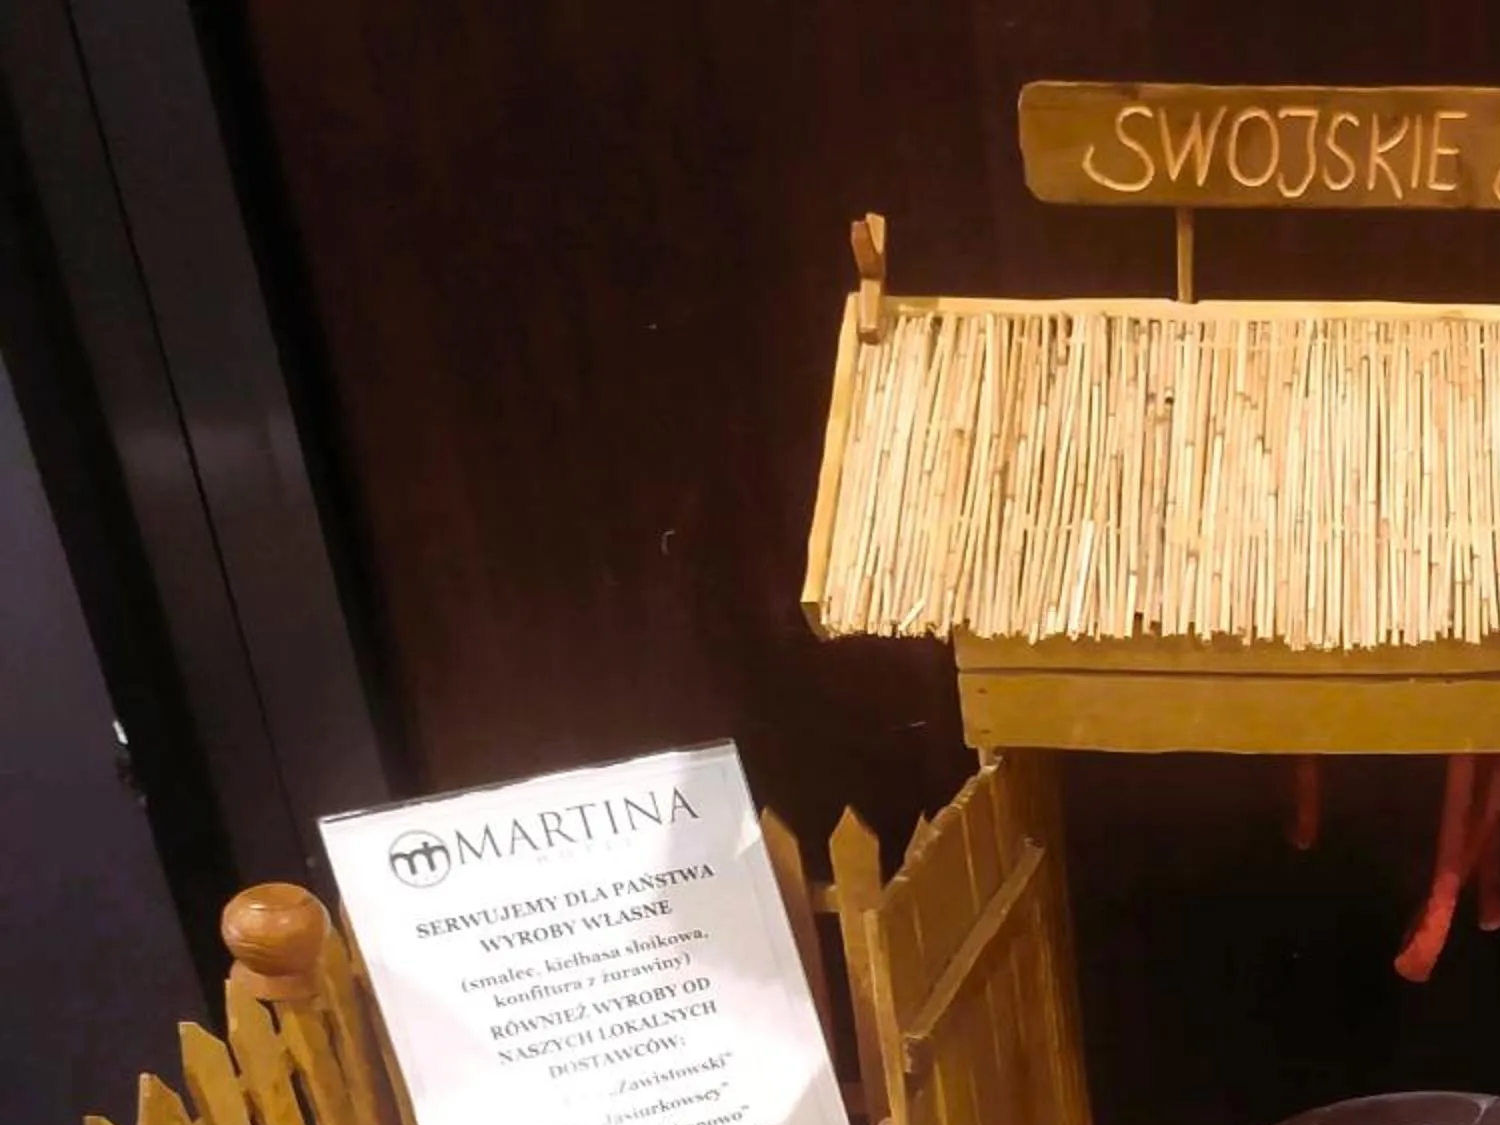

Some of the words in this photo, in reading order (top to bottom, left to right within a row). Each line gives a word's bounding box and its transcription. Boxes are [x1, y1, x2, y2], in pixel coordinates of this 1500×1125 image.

[1082, 105, 1468, 198] SWOJSKIE
[453, 785, 701, 866] MARTINA
[415, 895, 558, 940] SERWUJEMY
[564, 886, 607, 908] DLA
[612, 862, 716, 898] PAŃSTWA
[479, 919, 578, 954] WYROBY
[584, 898, 674, 927] WŁASNE
[489, 1003, 588, 1041] RÓWNIEŻ
[592, 984, 679, 1016] WYROBY
[681, 976, 713, 995] OD
[493, 979, 583, 1009] konfitura
[497, 1032, 594, 1065] NASZYCH
[599, 1000, 718, 1042] LOKALNYCH
